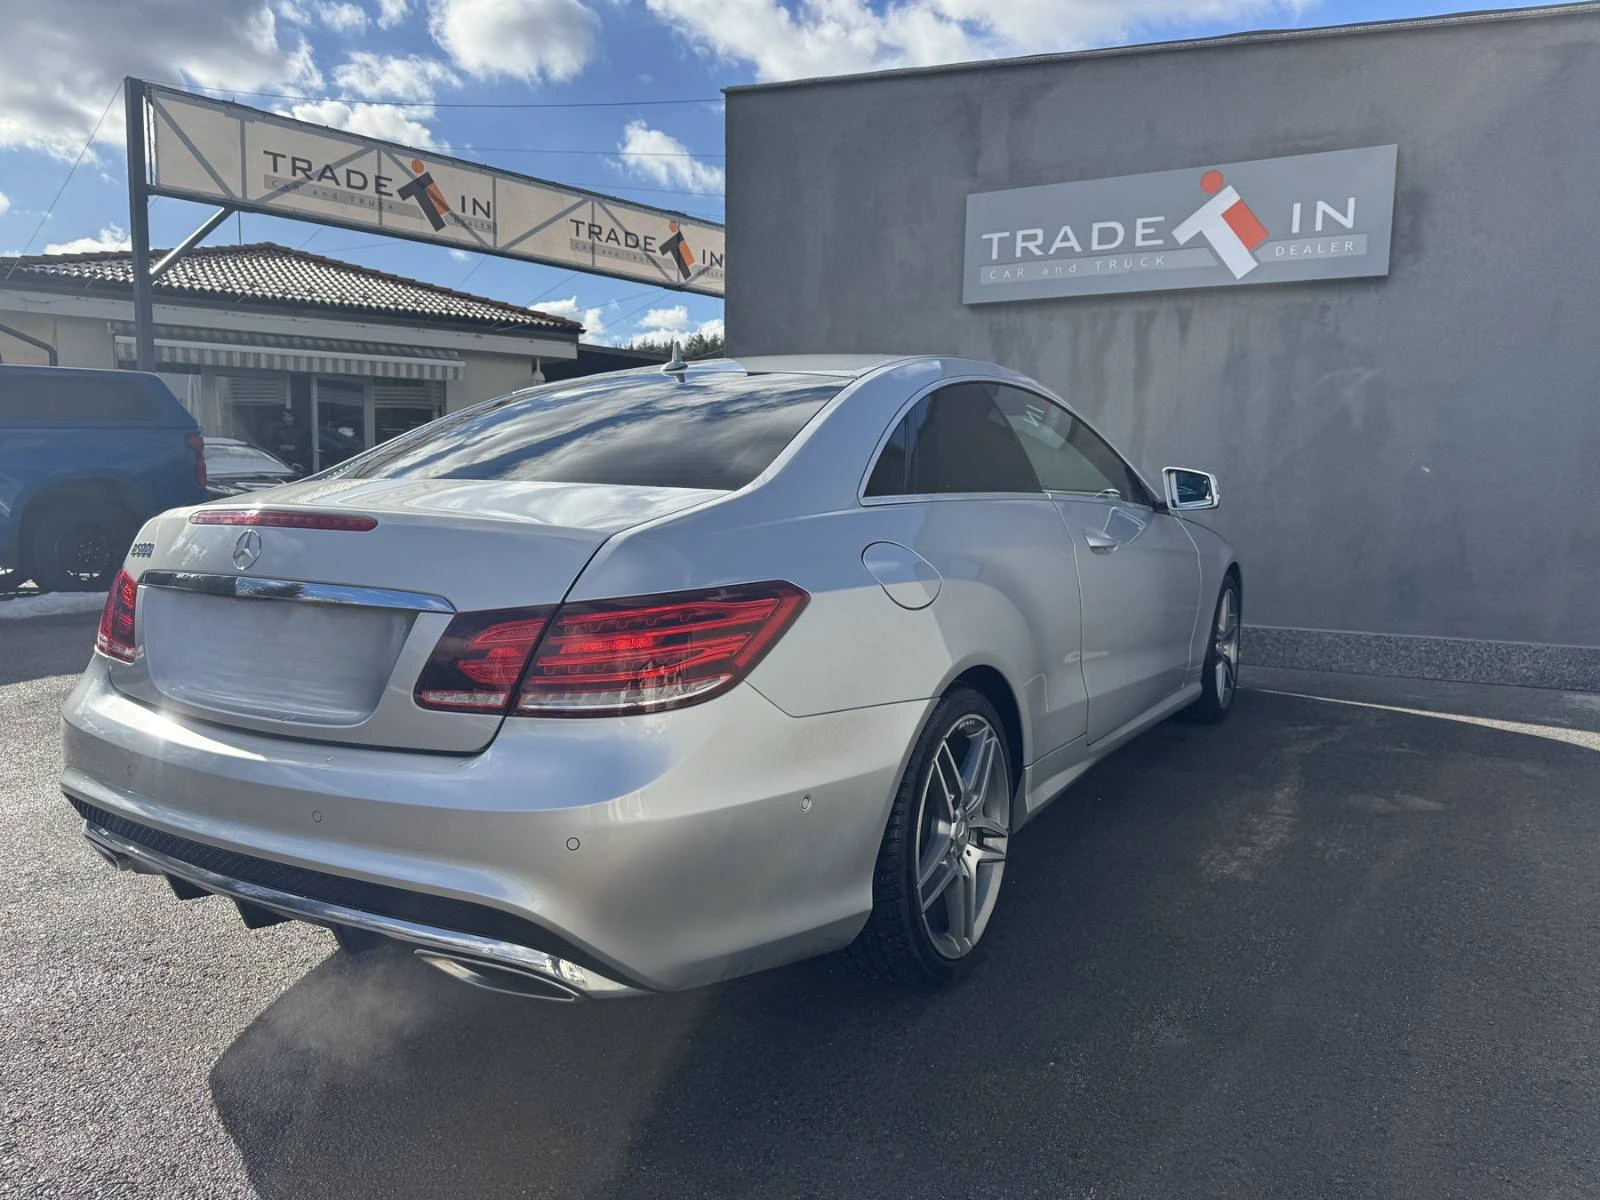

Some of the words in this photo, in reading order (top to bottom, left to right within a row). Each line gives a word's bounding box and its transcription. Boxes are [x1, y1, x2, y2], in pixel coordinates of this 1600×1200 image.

[263, 150, 393, 197] TRADE
[461, 195, 490, 219] IN
[570, 219, 656, 253] TRADE
[702, 249, 723, 268] IN
[982, 216, 1165, 260] TRADE
[1291, 197, 1356, 233] IN
[1275, 241, 1354, 257] DEALER
[989, 268, 1024, 280] CAR
[1041, 263, 1077, 276] and
[1096, 255, 1165, 271] TRUCK
